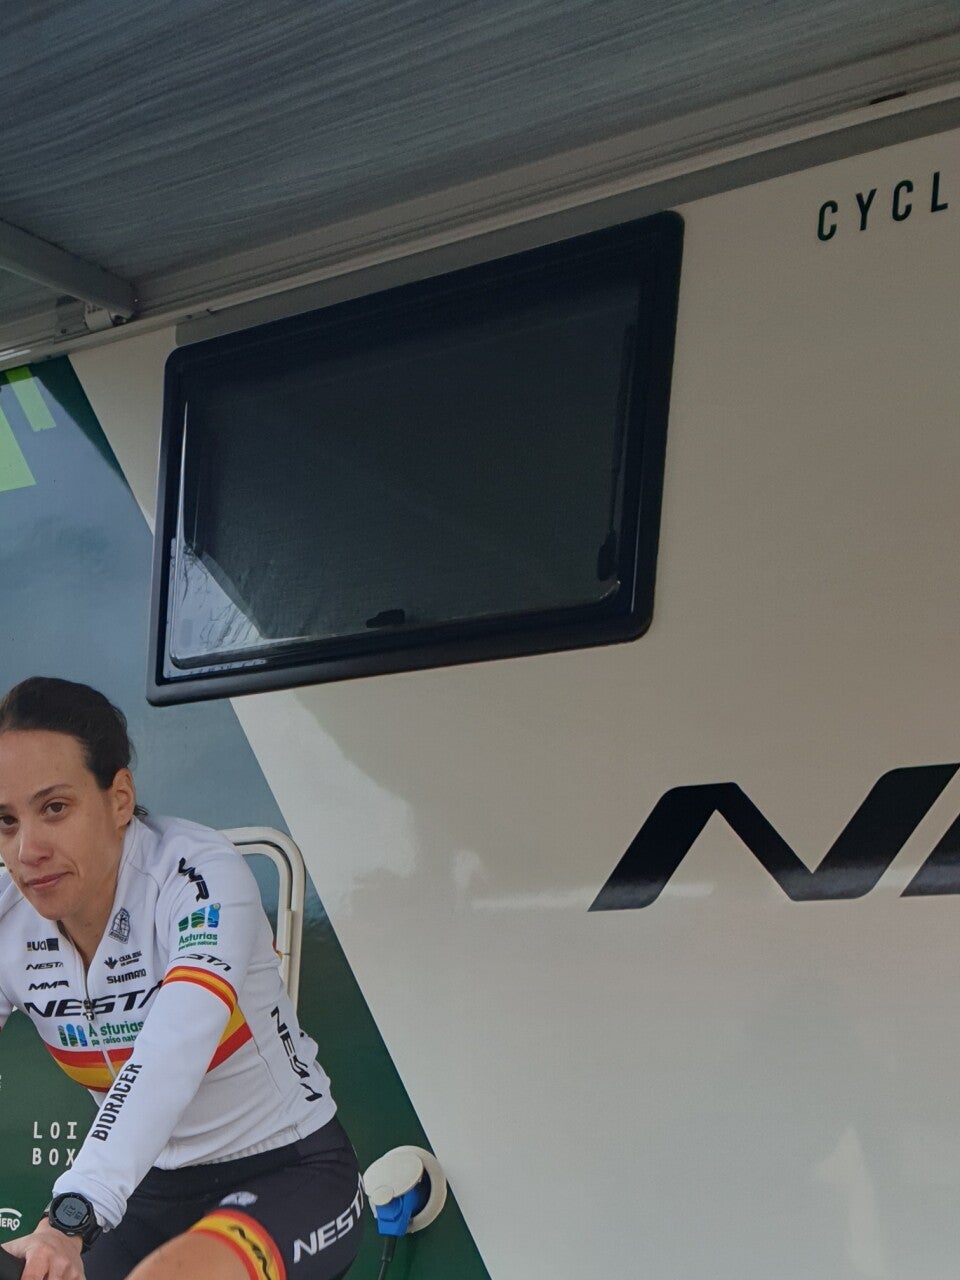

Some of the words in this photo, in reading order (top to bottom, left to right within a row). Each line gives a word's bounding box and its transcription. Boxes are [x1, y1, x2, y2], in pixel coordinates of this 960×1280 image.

[25, 961, 64, 971] NESTA
[106, 968, 147, 984] SHIMANO
[28, 980, 70, 991] MMR
[89, 1020, 144, 1037] Asturias
[91, 1063, 142, 1141] BIORACER
[32, 1148, 75, 1166] BOX
